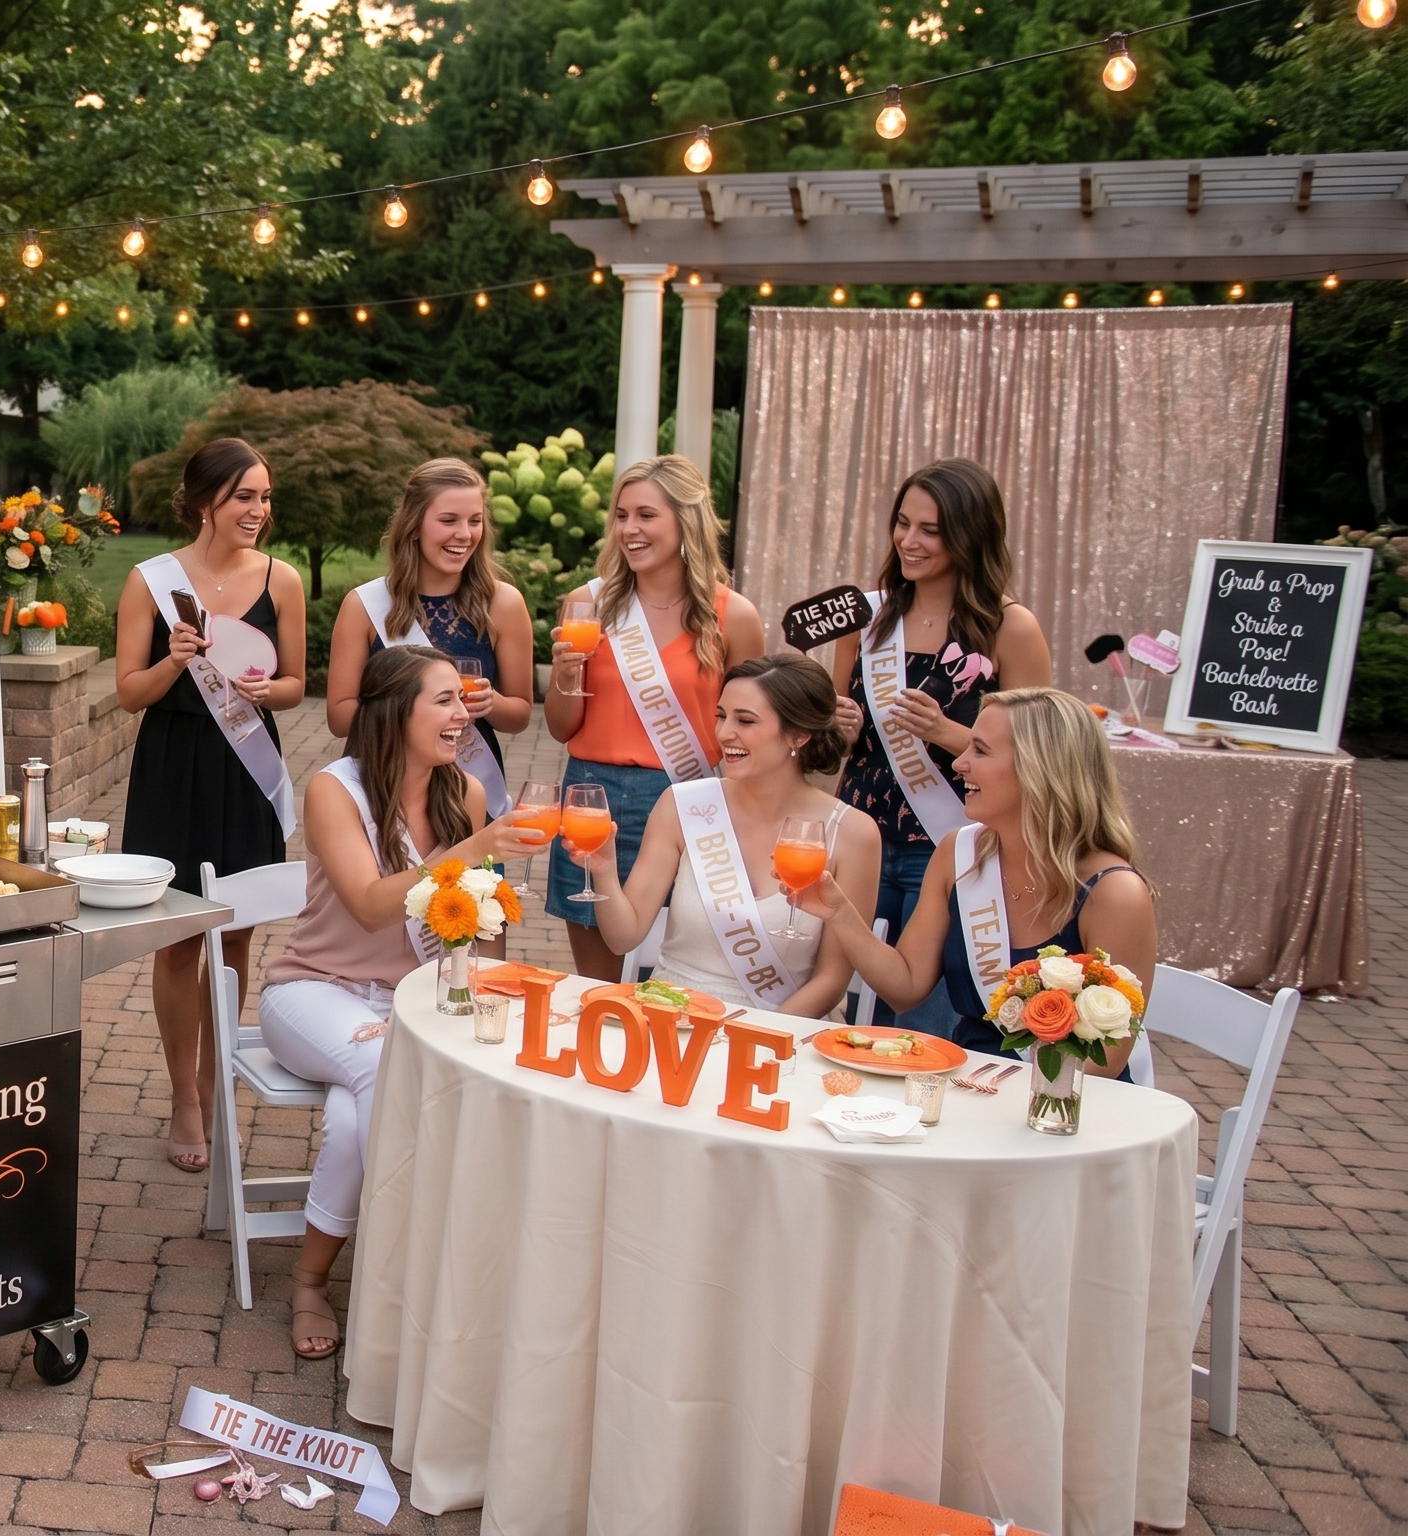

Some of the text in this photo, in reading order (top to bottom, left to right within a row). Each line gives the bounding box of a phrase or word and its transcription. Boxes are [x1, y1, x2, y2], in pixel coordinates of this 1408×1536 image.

[1218, 569, 1334, 602] Grab a Prop
[792, 591, 858, 626] TIE THE
[1268, 597, 1281, 612] &
[805, 607, 858, 640] KNOT
[1232, 612, 1303, 637] Strike a
[1239, 638, 1291, 661] Pose!
[619, 624, 657, 684] MAID
[638, 684, 671, 712] OF
[1203, 662, 1318, 692] Bachelorette
[871, 642, 939, 795] TEAM BRIDE
[1230, 691, 1279, 715] Bash
[695, 831, 785, 999] BRIDE-TO-BE
[969, 898, 1005, 987] TEAM
[515, 976, 794, 1132] LOVE
[209, 1402, 366, 1474] TIE THE KNOT
